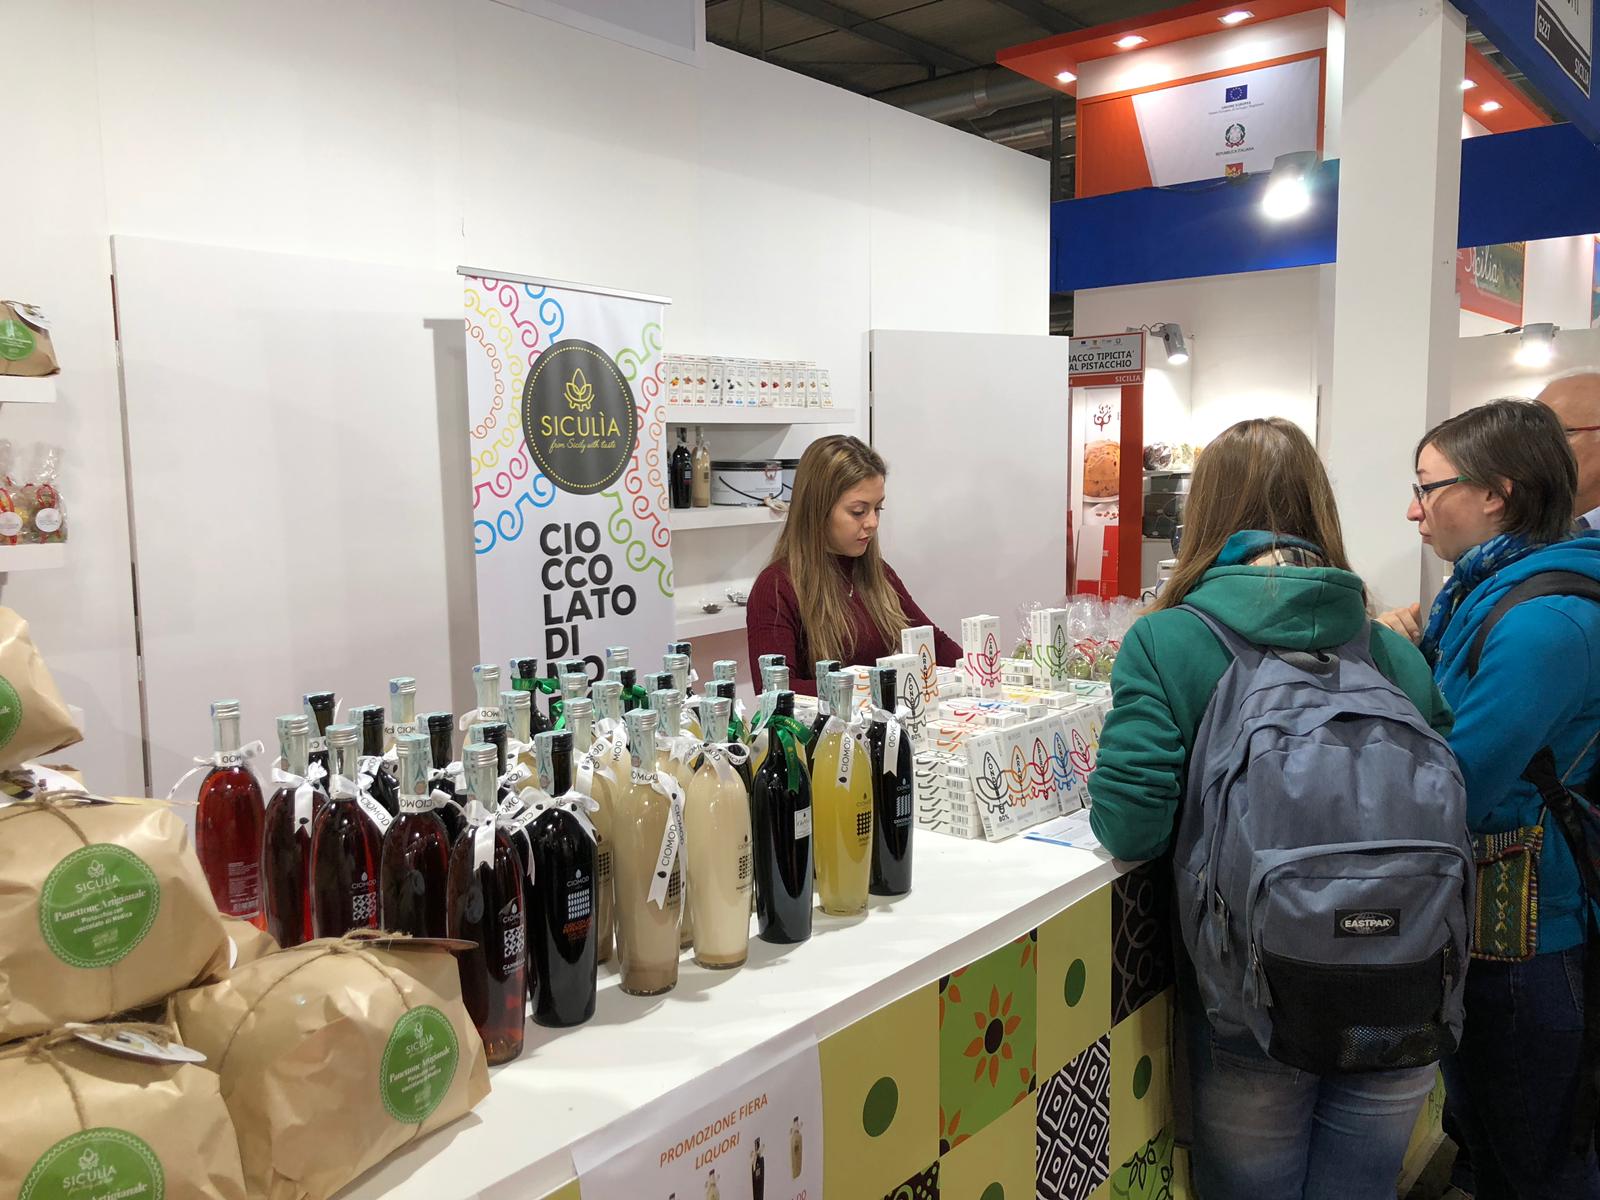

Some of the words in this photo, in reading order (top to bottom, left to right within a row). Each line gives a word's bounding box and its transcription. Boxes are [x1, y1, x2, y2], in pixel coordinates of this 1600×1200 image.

[1081, 360, 1132, 370] PISTACCHIO
[1114, 374, 1141, 383] SICILIA
[541, 411, 621, 437] SICULÌA
[549, 438, 566, 454] from
[567, 438, 587, 453] Sicily
[587, 439, 600, 449] with
[601, 440, 617, 449] taste
[540, 521, 601, 556] CIO
[541, 554, 613, 591] CCO
[544, 584, 637, 625] LATO
[545, 624, 580, 660] DI
[840, 736, 851, 773] CIOMOD
[360, 796, 391, 827] CIOMOD
[661, 824, 677, 866] CIOMOD
[351, 879, 377, 890] CIOMOD
[566, 876, 590, 888] CIOMOD
[1344, 919, 1391, 928] EASTPAK
[660, 1110, 736, 1168] PROMOZIONE
[739, 1093, 769, 1121] FIERA
[695, 1131, 740, 1171] LIQUORI
